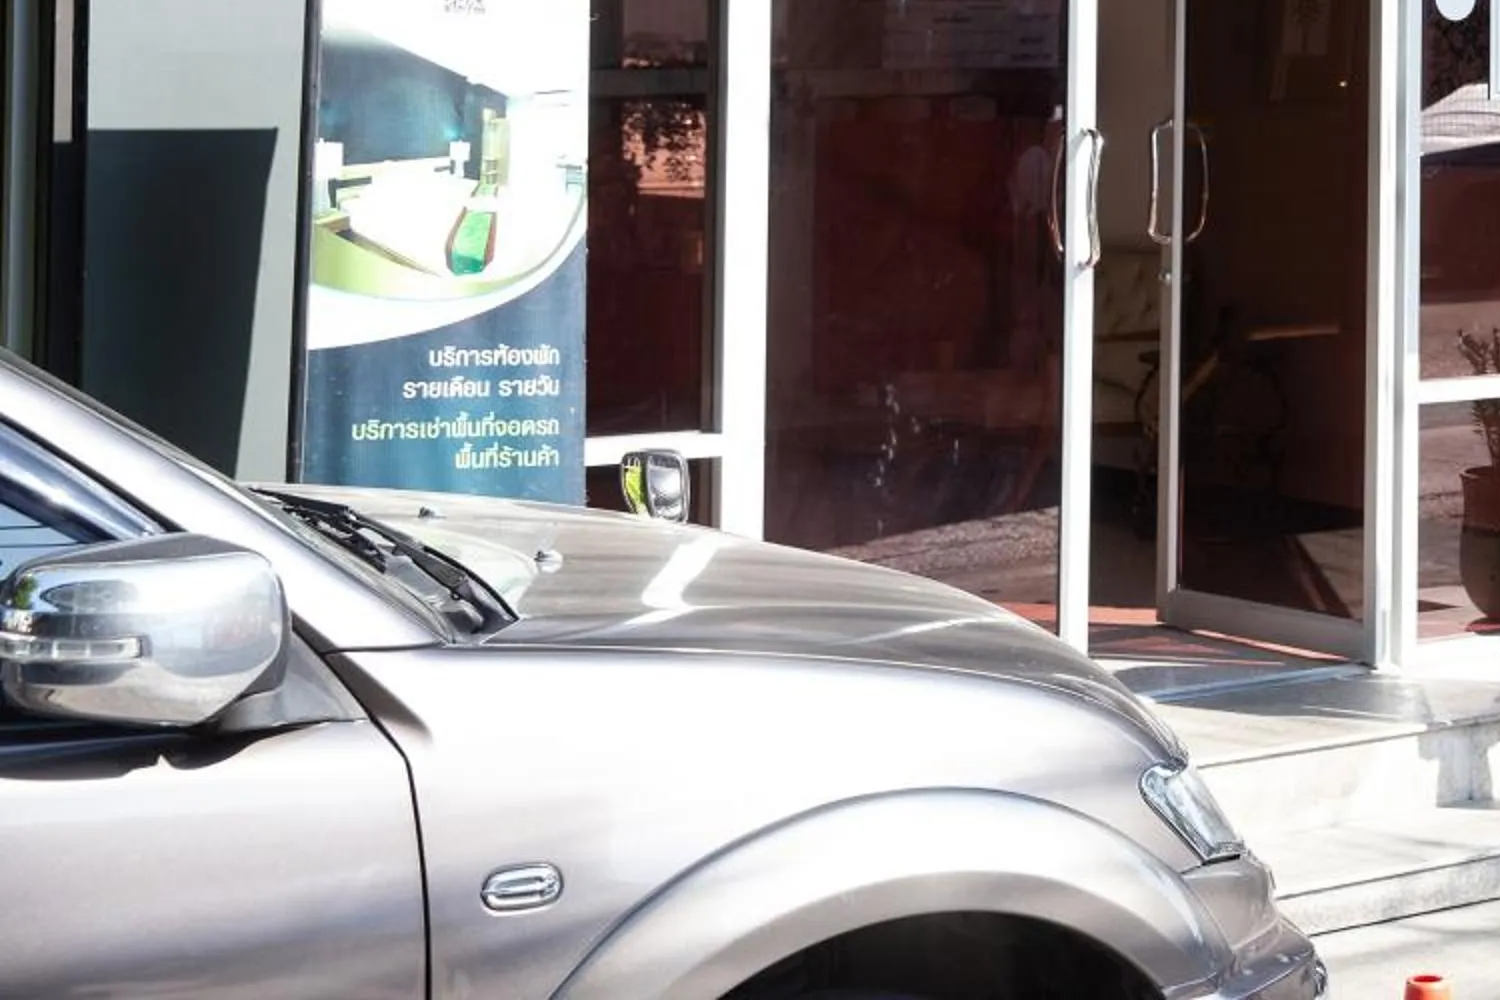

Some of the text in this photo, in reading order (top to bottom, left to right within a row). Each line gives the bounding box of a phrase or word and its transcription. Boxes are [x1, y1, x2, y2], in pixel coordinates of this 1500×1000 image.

[429, 343, 560, 368] บริการห้องพัก
[402, 374, 560, 399] รายเดือน รายวัน
[455, 441, 560, 469] พื้นที่ร้านค้า
